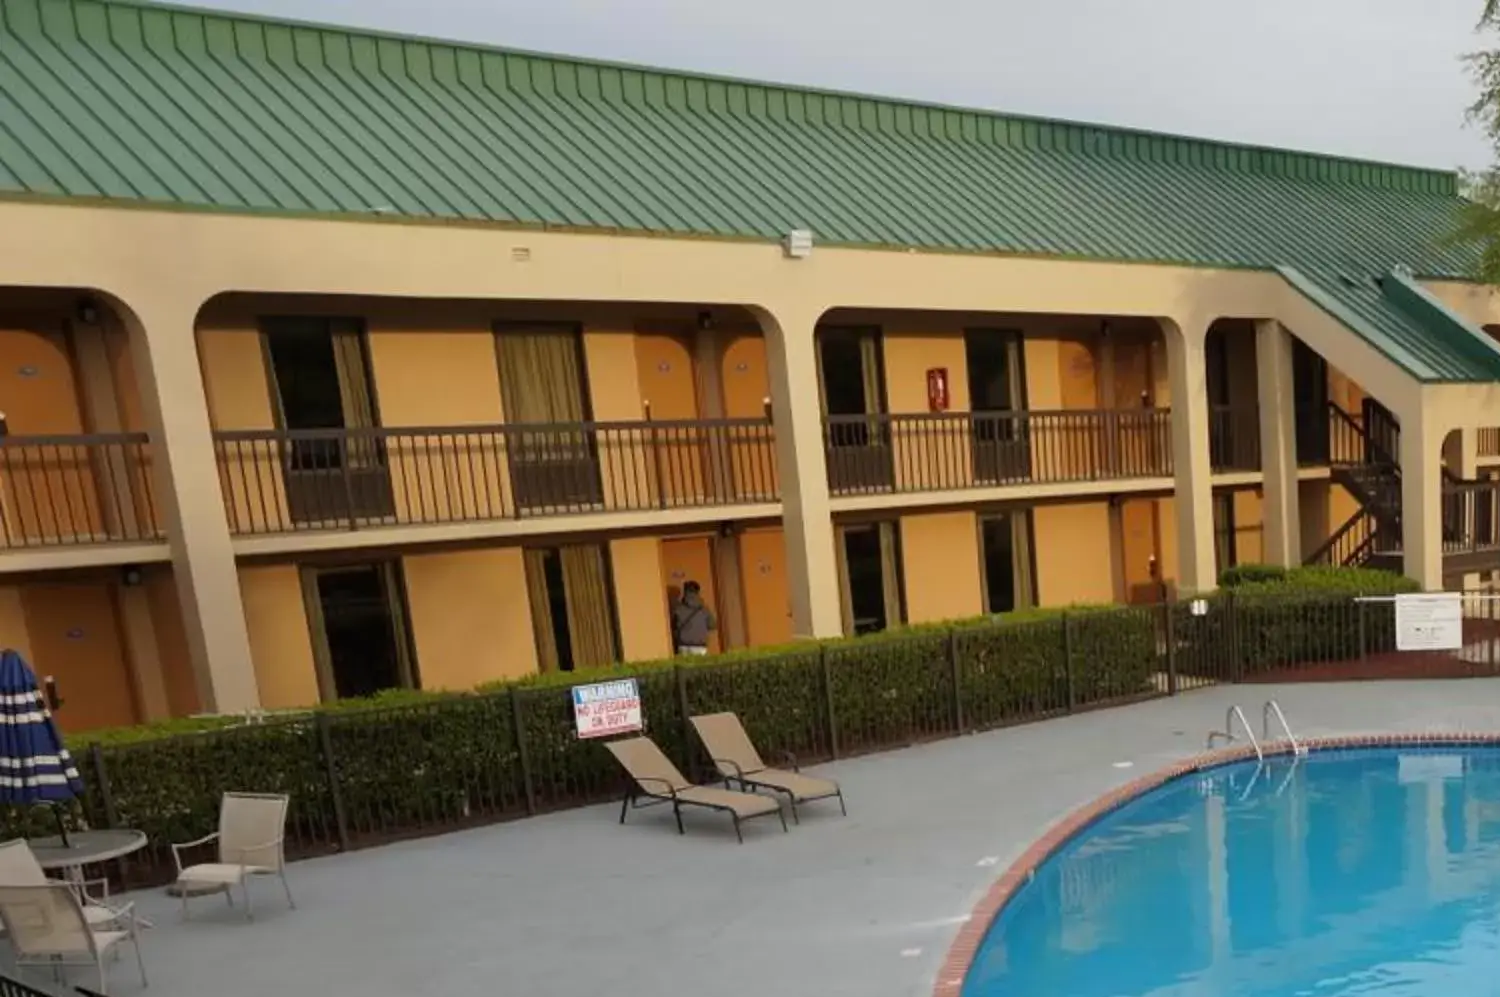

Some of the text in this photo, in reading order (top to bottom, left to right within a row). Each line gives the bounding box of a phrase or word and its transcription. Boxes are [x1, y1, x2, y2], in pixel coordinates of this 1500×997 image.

[577, 682, 634, 704] WARNING
[577, 699, 637, 716] NO LIFEGUARD
[607, 712, 627, 727] DUTY
